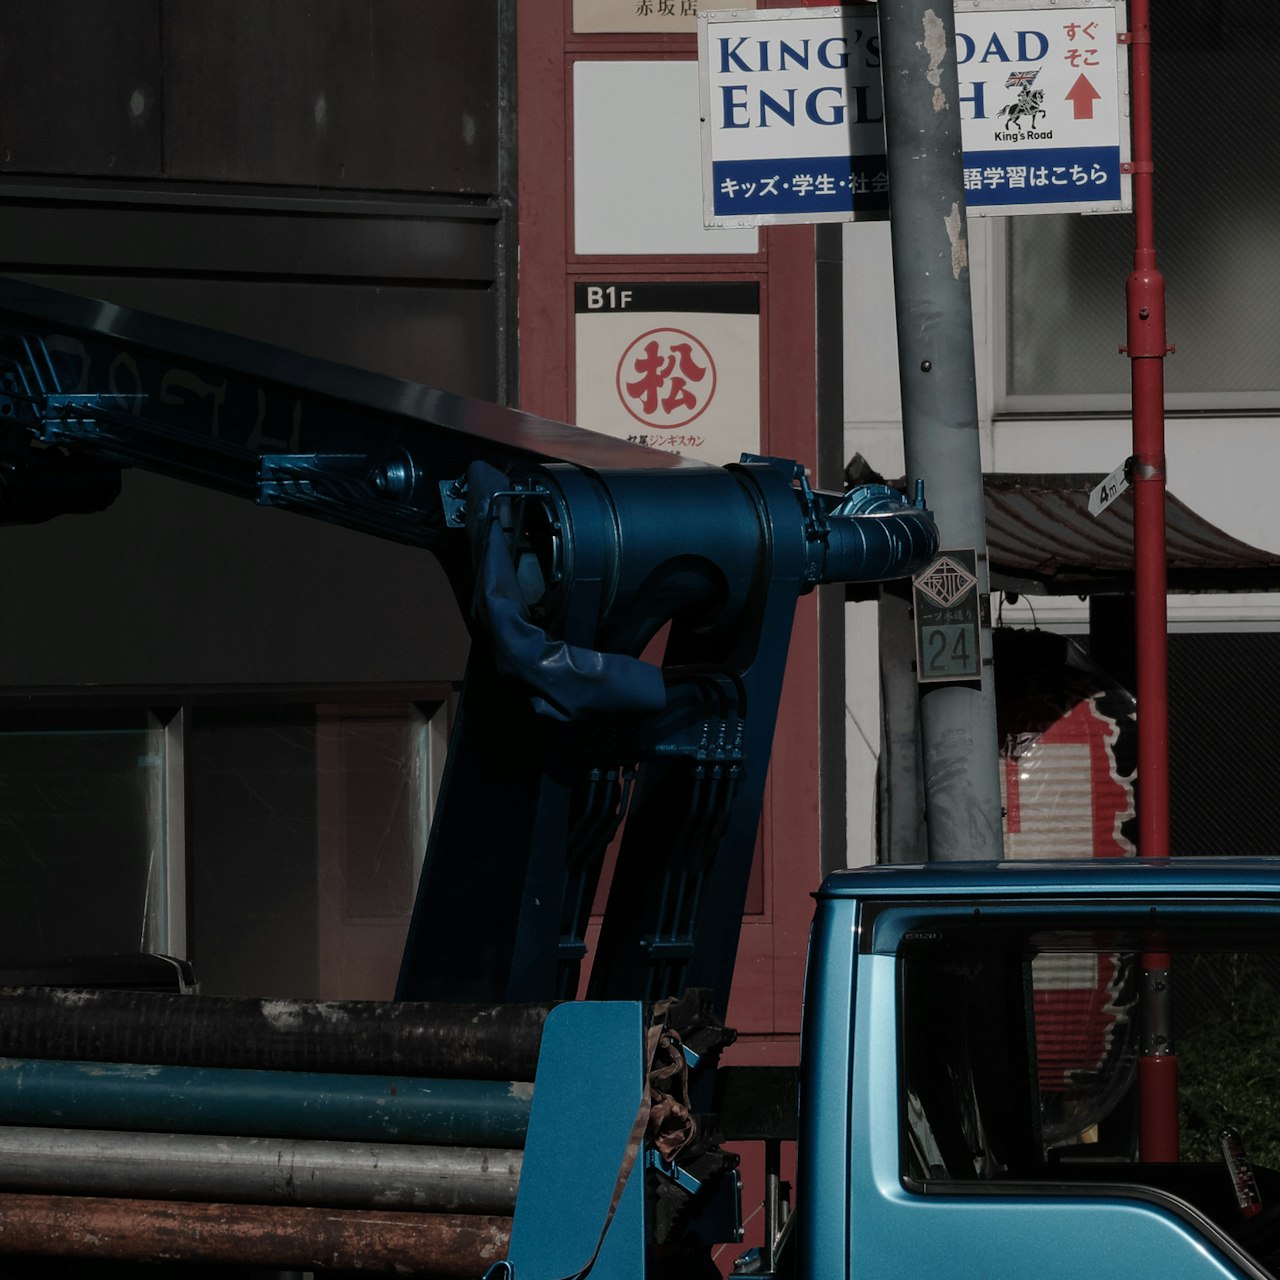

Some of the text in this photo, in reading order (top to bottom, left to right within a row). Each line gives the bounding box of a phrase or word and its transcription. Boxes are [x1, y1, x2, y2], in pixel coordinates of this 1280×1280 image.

[635, 0, 697, 17] 赤坂店
[1063, 21, 1099, 41] すぐ
[717, 29, 1049, 73] KING'S OAD
[1064, 48, 1100, 67] そこ
[719, 81, 990, 129] ENGLH
[994, 130, 1053, 142] King's Road
[586, 285, 633, 310] B1F
[626, 340, 707, 415] 松
[928, 628, 970, 671] 24
